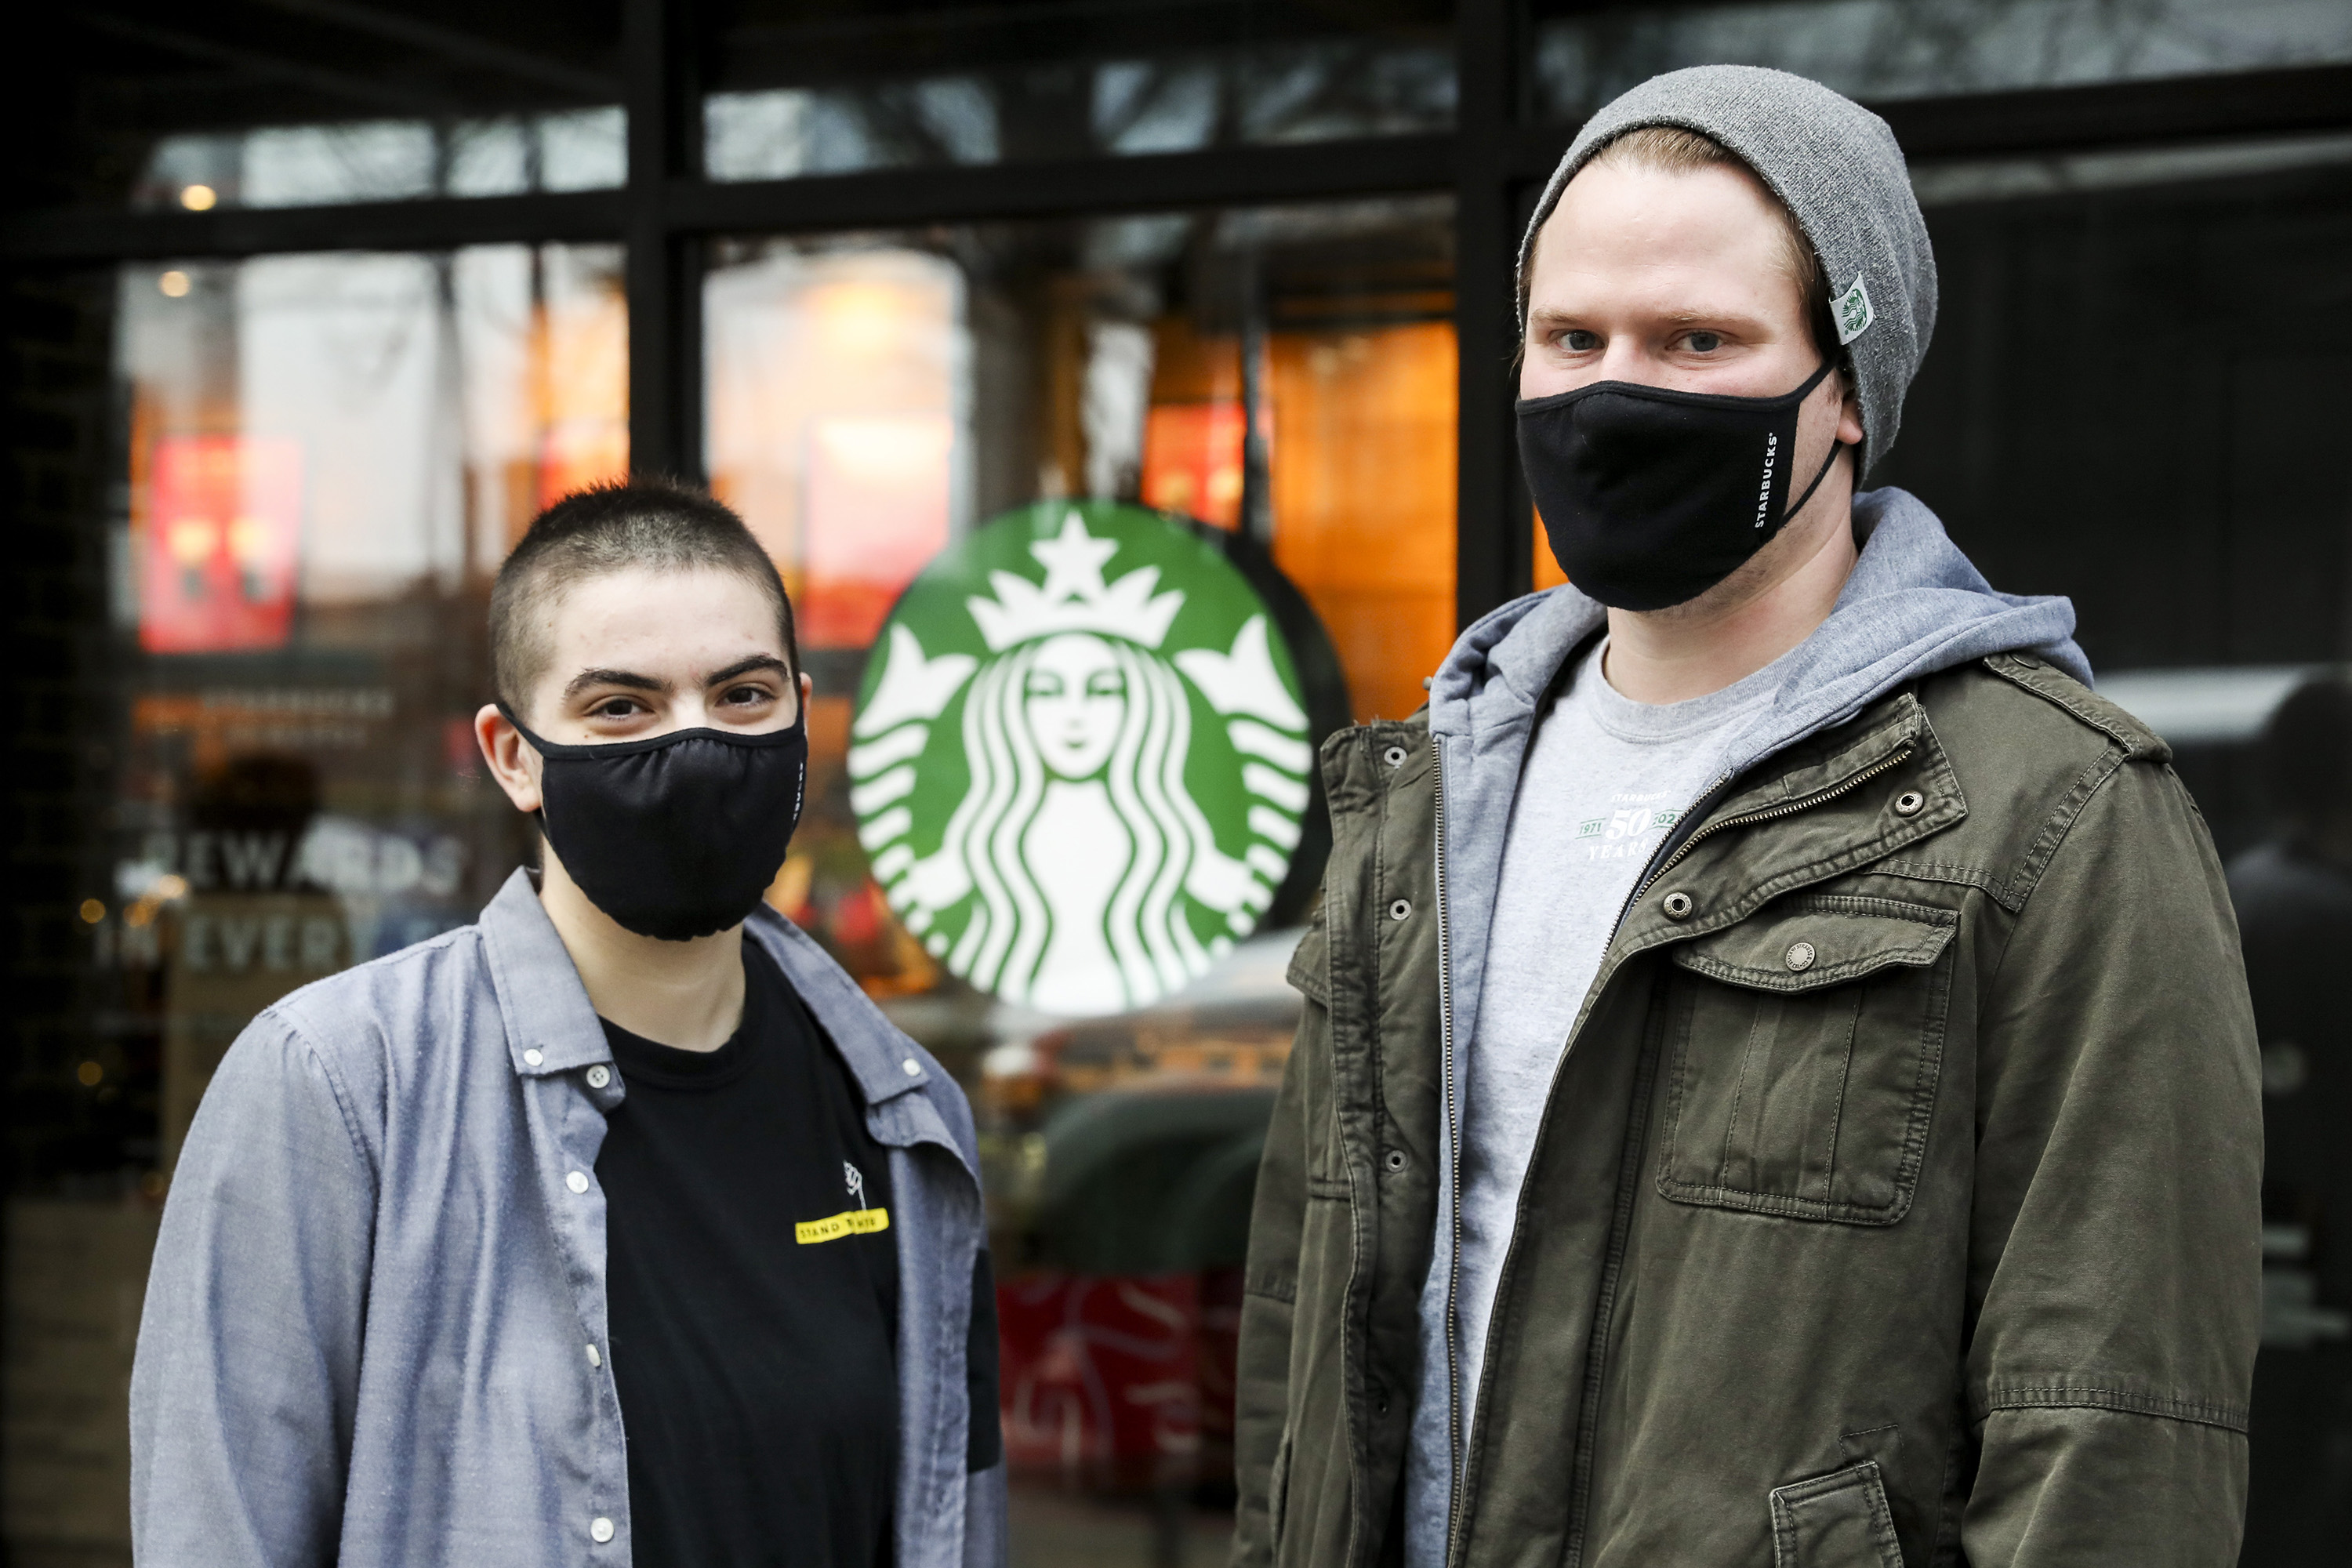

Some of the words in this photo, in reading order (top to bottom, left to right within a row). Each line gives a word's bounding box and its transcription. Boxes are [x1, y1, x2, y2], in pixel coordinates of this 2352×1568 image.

[1755, 434, 1777, 528] STARBUCKS
[1611, 790, 1668, 803] STARBUCKS
[1579, 822, 1602, 835] 1971
[1605, 808, 1651, 840] 50
[1588, 837, 1649, 861] YEARS
